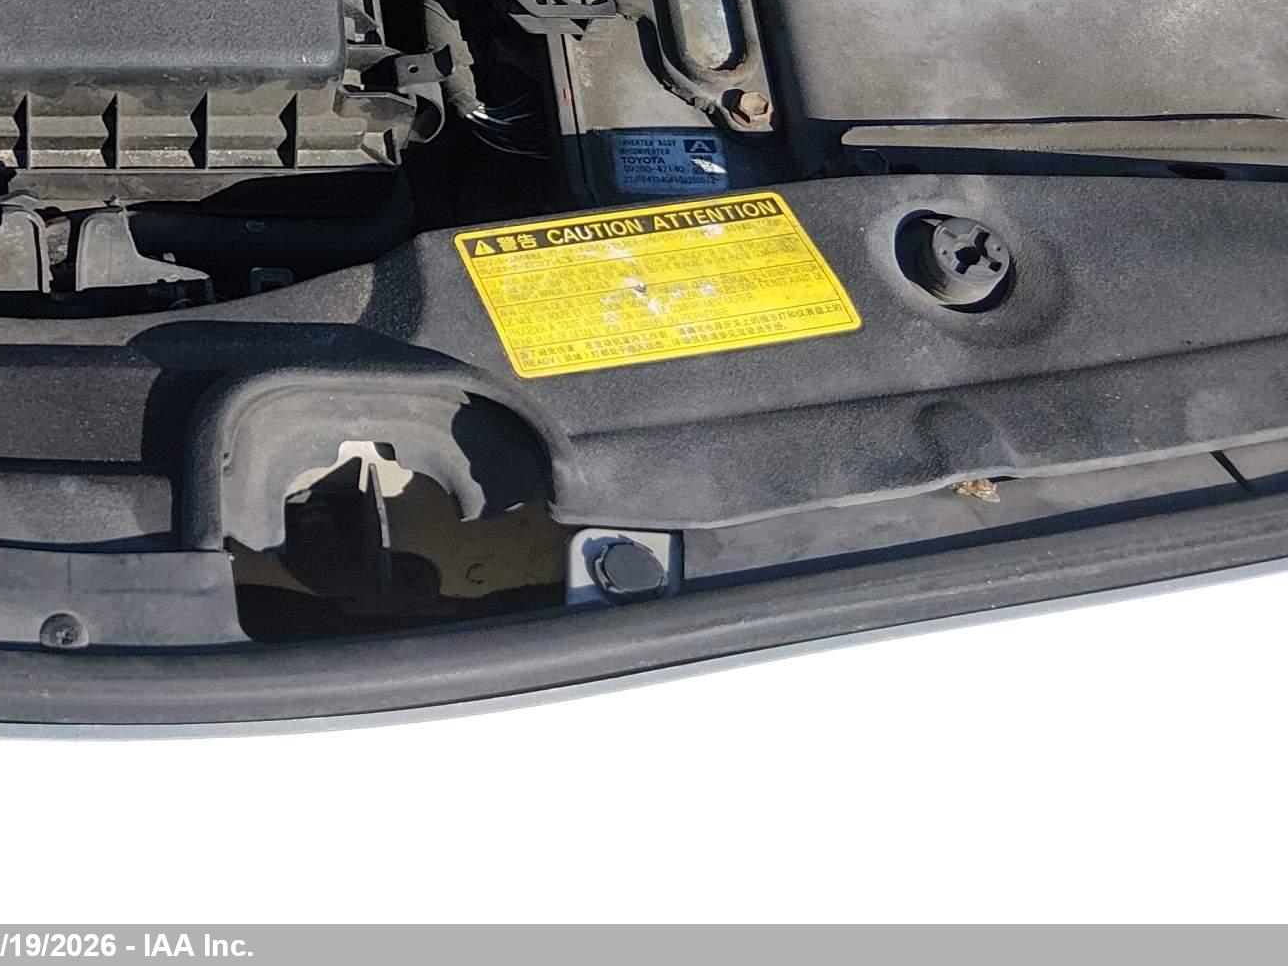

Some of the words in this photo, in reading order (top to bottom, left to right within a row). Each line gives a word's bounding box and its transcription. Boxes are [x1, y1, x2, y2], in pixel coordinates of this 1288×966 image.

[621, 156, 665, 164] TOYOTA
[546, 220, 646, 246] CAUTION
[653, 199, 776, 232] ATTENTION
[497, 234, 540, 251] 警告
